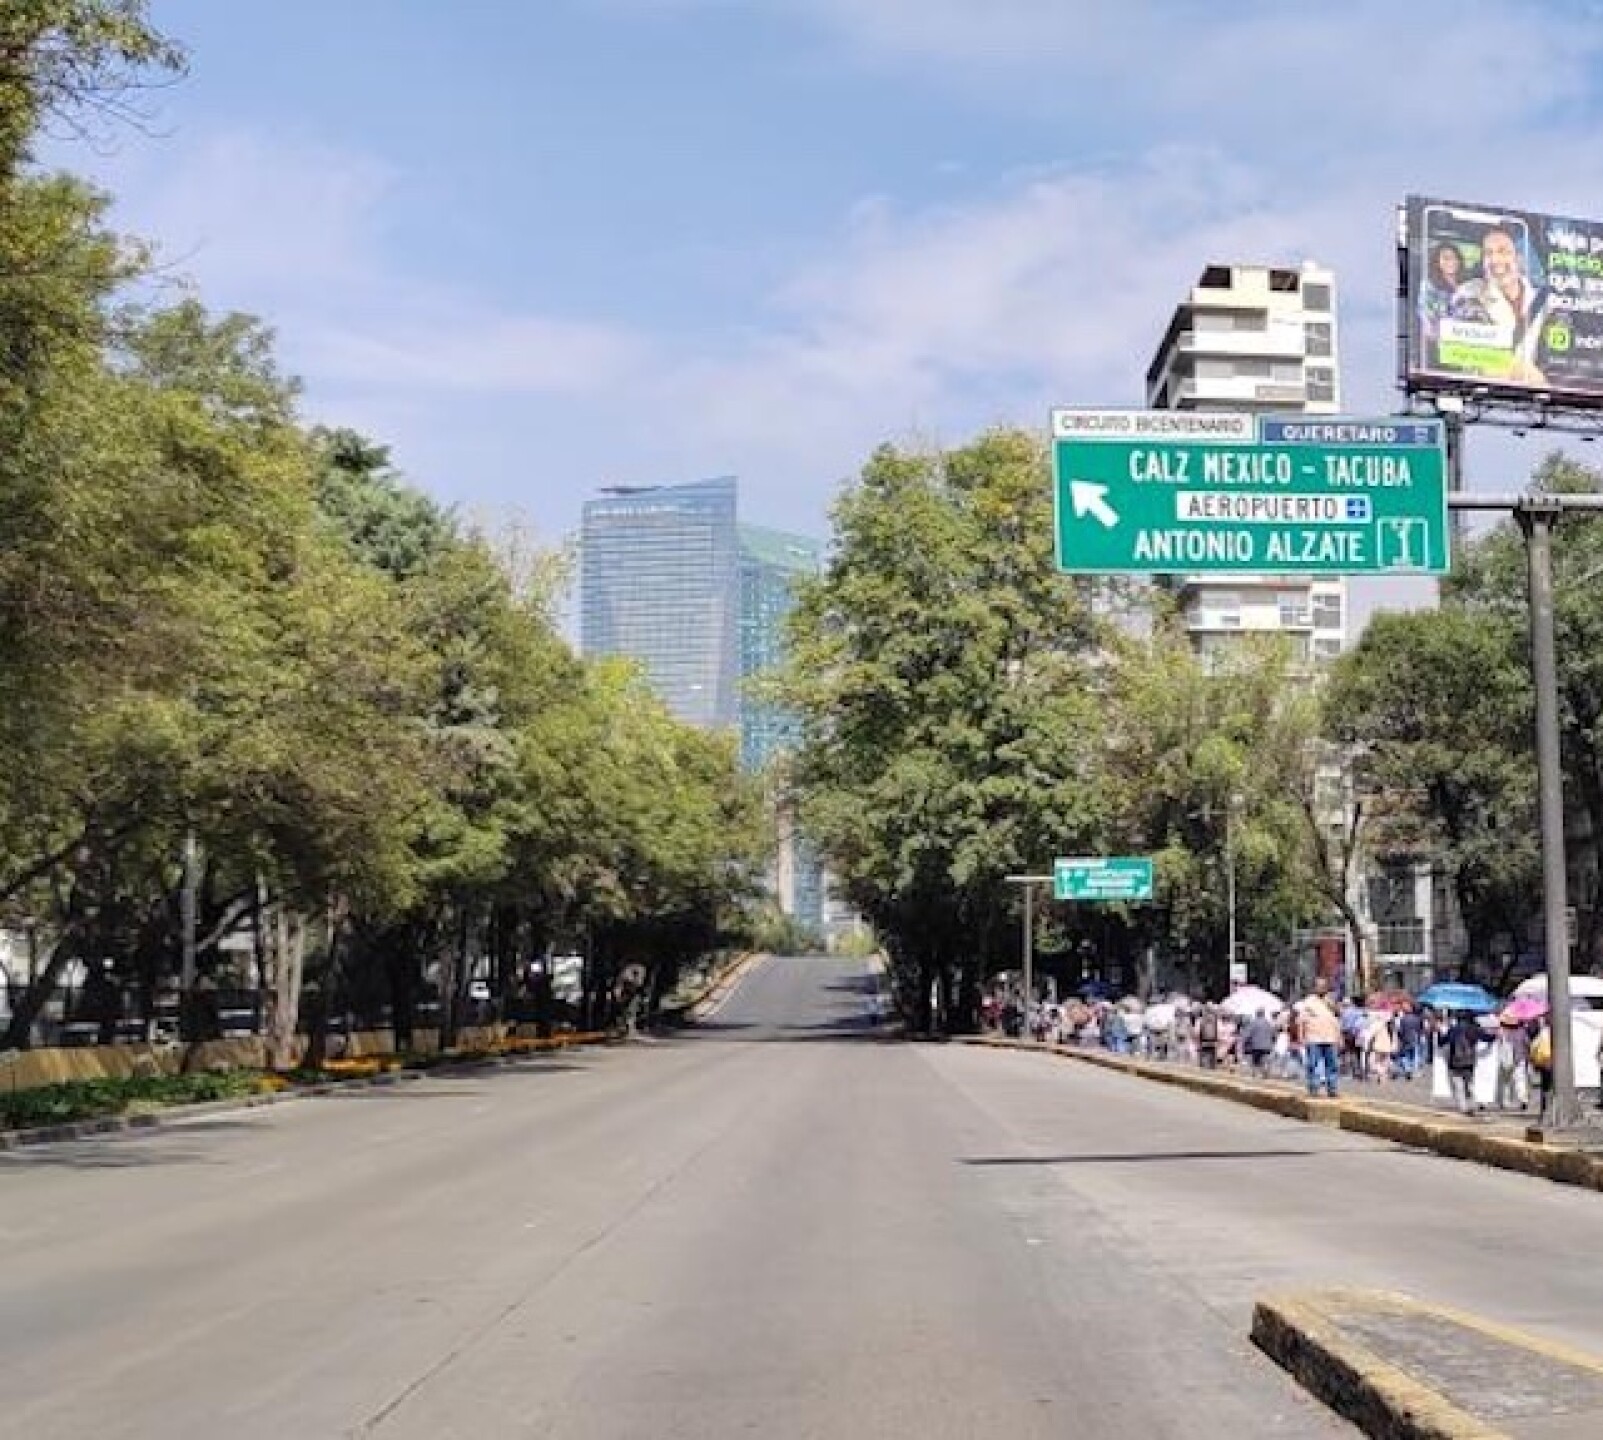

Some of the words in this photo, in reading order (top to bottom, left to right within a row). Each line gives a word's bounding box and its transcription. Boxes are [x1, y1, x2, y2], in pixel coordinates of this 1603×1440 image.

[1062, 415, 1130, 431] CIRCUITO
[1136, 416, 1245, 433] BICENTENARIO
[1281, 424, 1396, 442] QUERETARO
[1129, 450, 1190, 482] CALZ
[1203, 453, 1291, 484] MEXICO
[1323, 455, 1412, 487] TACUBA
[1187, 496, 1338, 520] AEROPUERTO
[1133, 530, 1253, 561] ANTONIO
[1266, 531, 1366, 562] ALZATE
